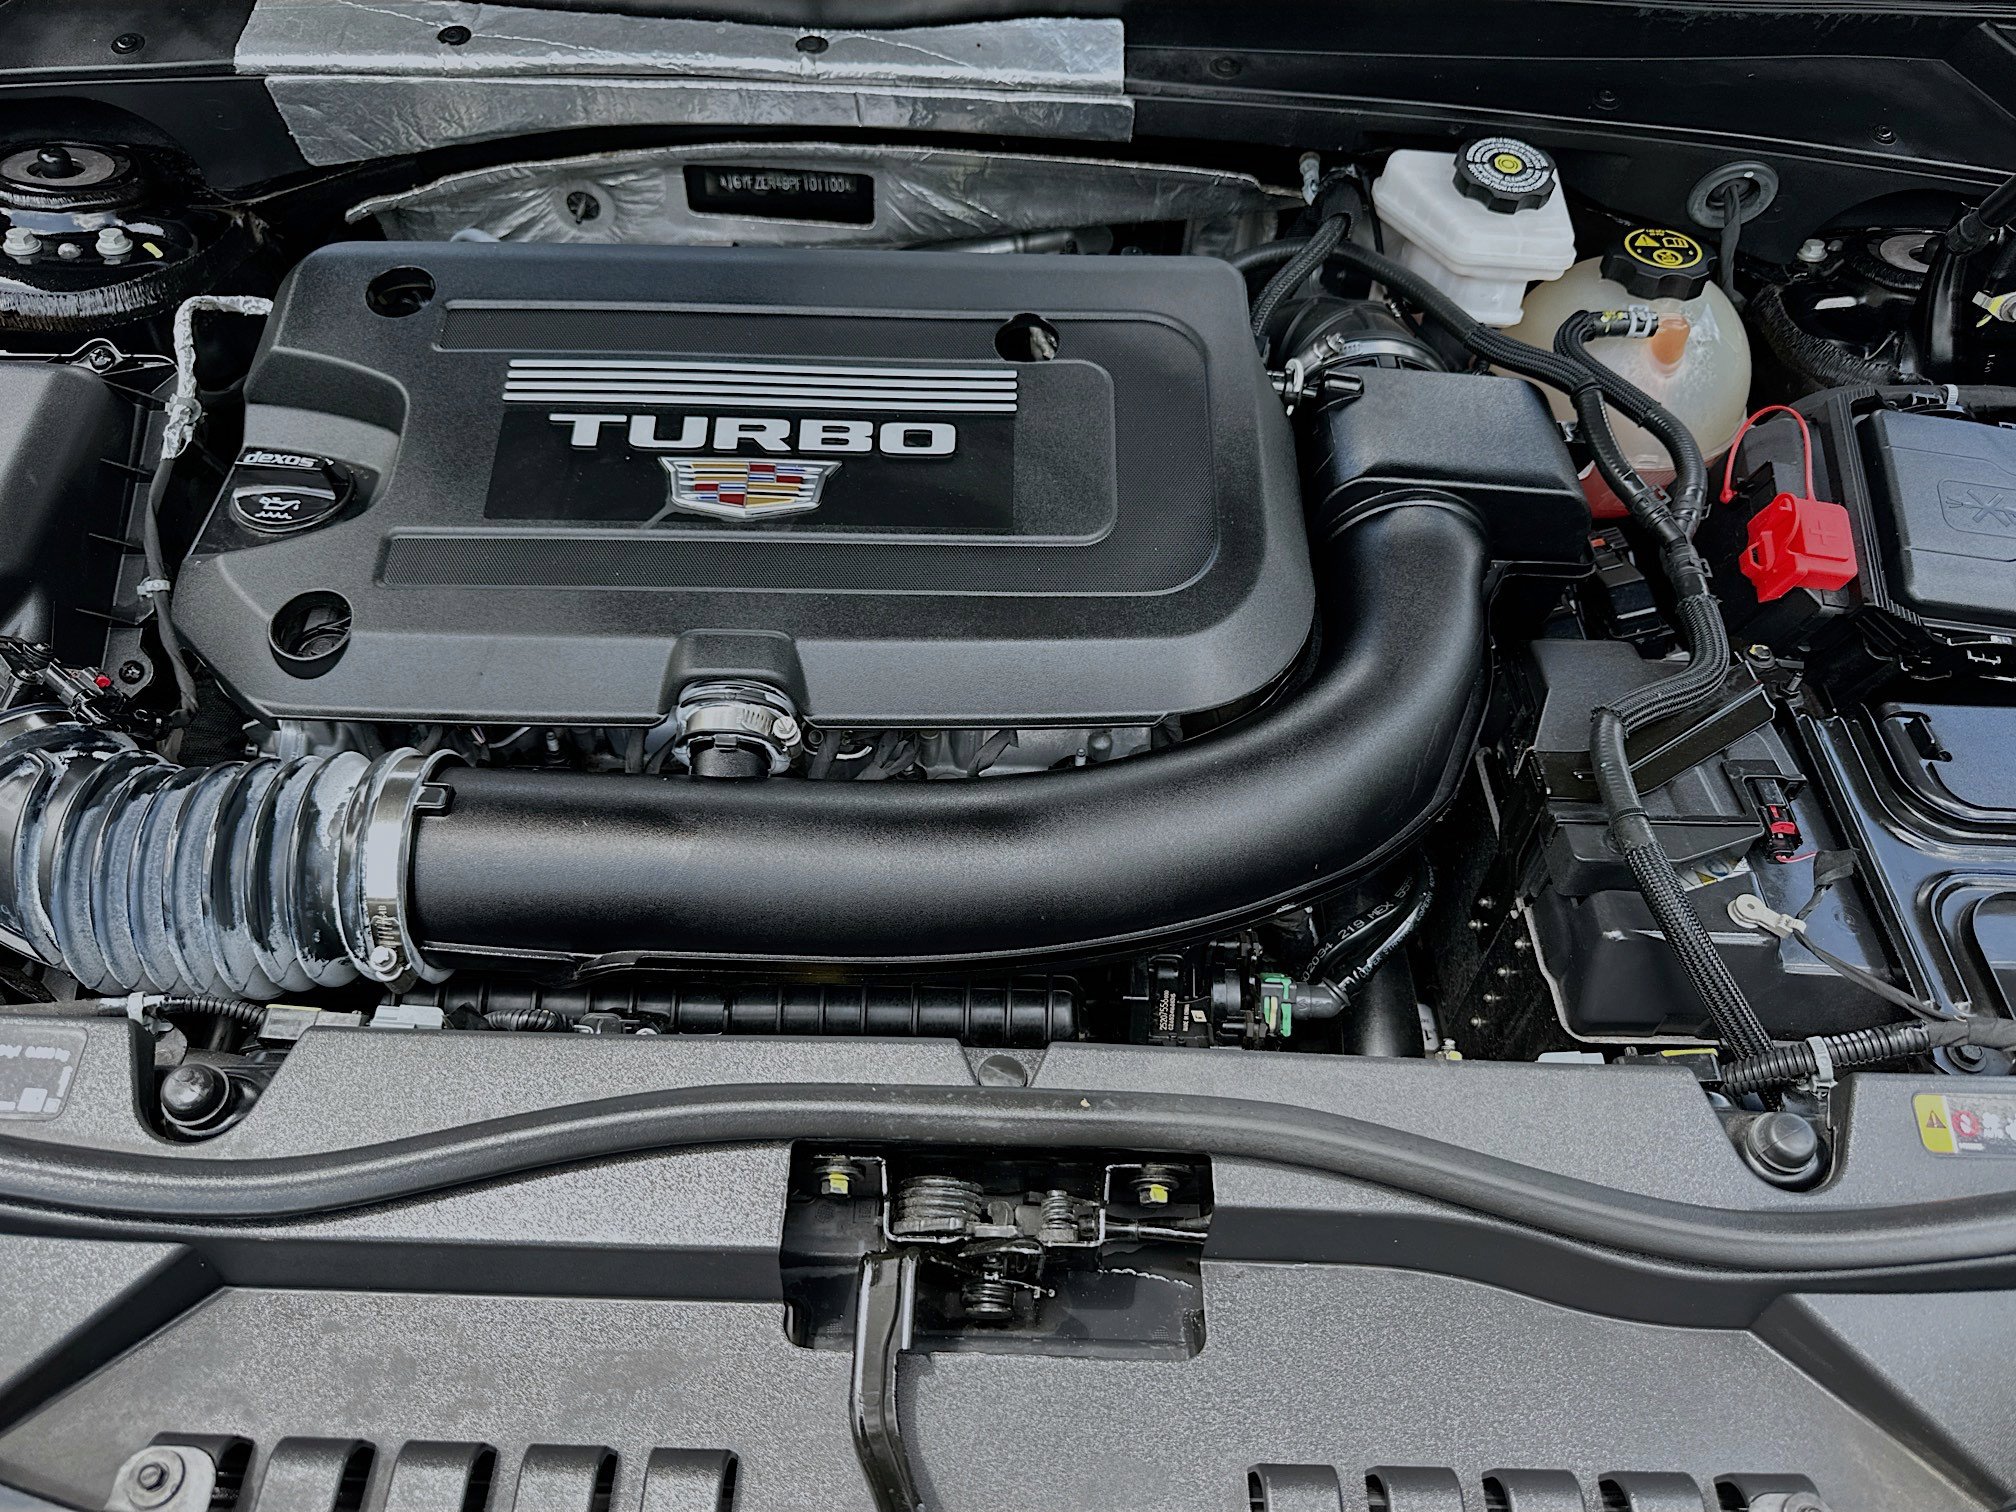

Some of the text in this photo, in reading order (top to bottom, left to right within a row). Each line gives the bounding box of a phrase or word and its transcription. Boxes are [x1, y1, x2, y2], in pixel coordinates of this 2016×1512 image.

[549, 413, 956, 455] TURBO
[243, 451, 318, 467] dexos
[1302, 942, 1334, 982] 02034
[1367, 901, 1394, 920] MEX
